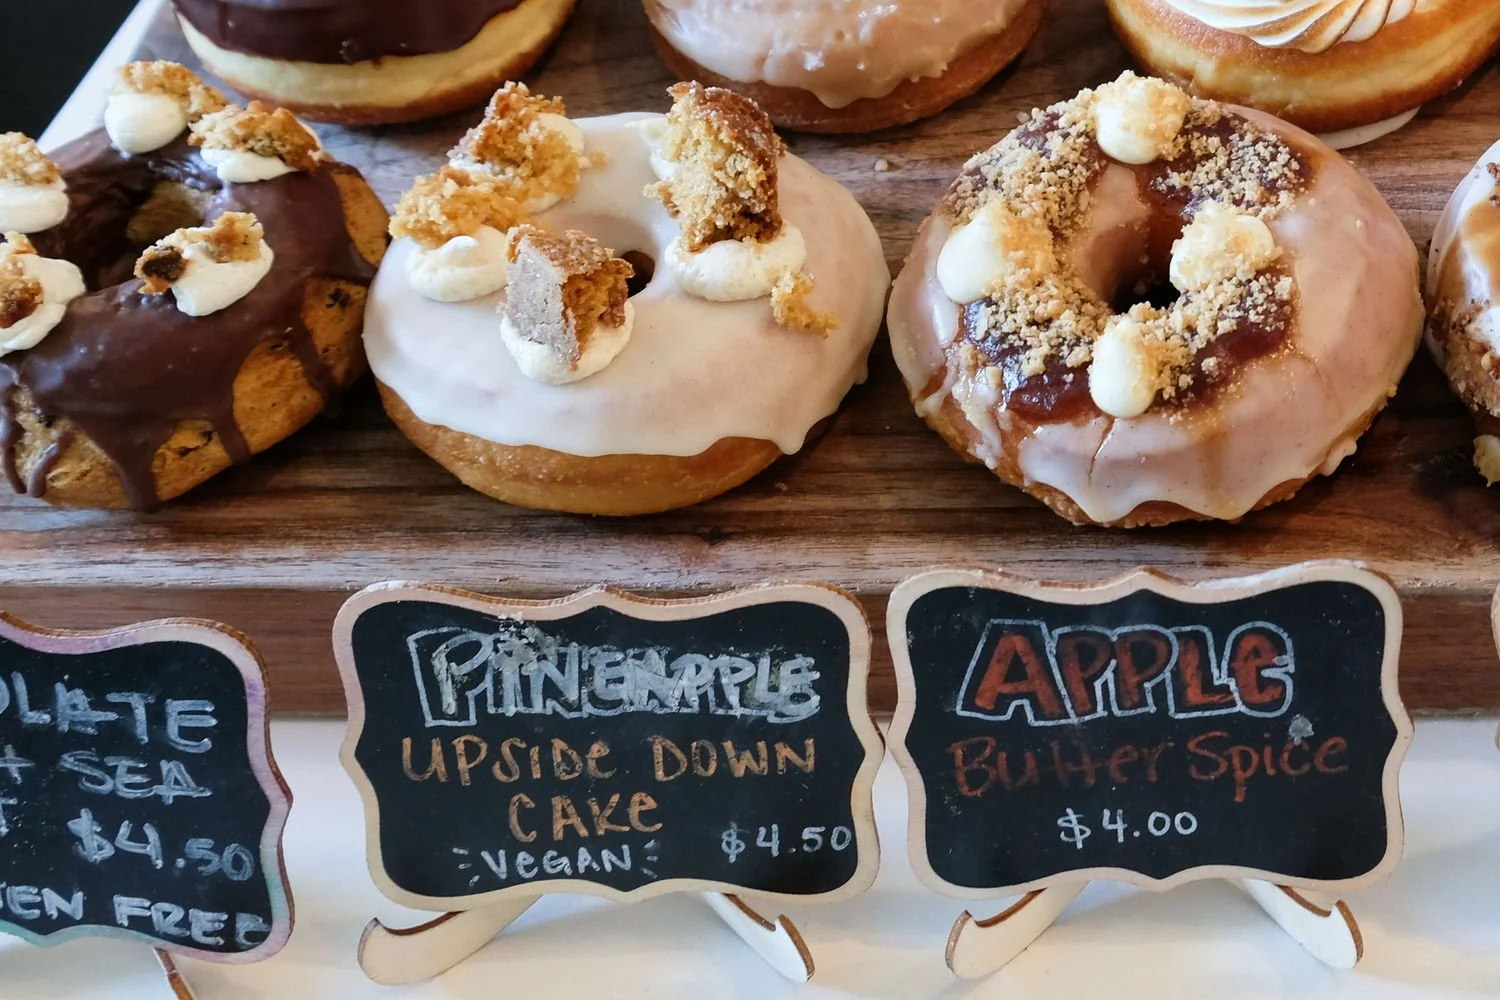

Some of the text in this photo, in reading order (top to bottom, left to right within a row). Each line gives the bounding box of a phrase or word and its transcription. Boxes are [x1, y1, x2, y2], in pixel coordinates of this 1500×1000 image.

[407, 626, 821, 728] PINEAPPLE
[0, 671, 217, 753] LATE
[59, 750, 212, 804] SEA
[653, 734, 816, 782] DOWN
[946, 731, 1349, 802] Butter Spice
[67, 808, 255, 881] $4.50
[720, 823, 852, 863] $4.50
[1057, 808, 1198, 850] $4.00
[0, 882, 272, 946] EN FREE
